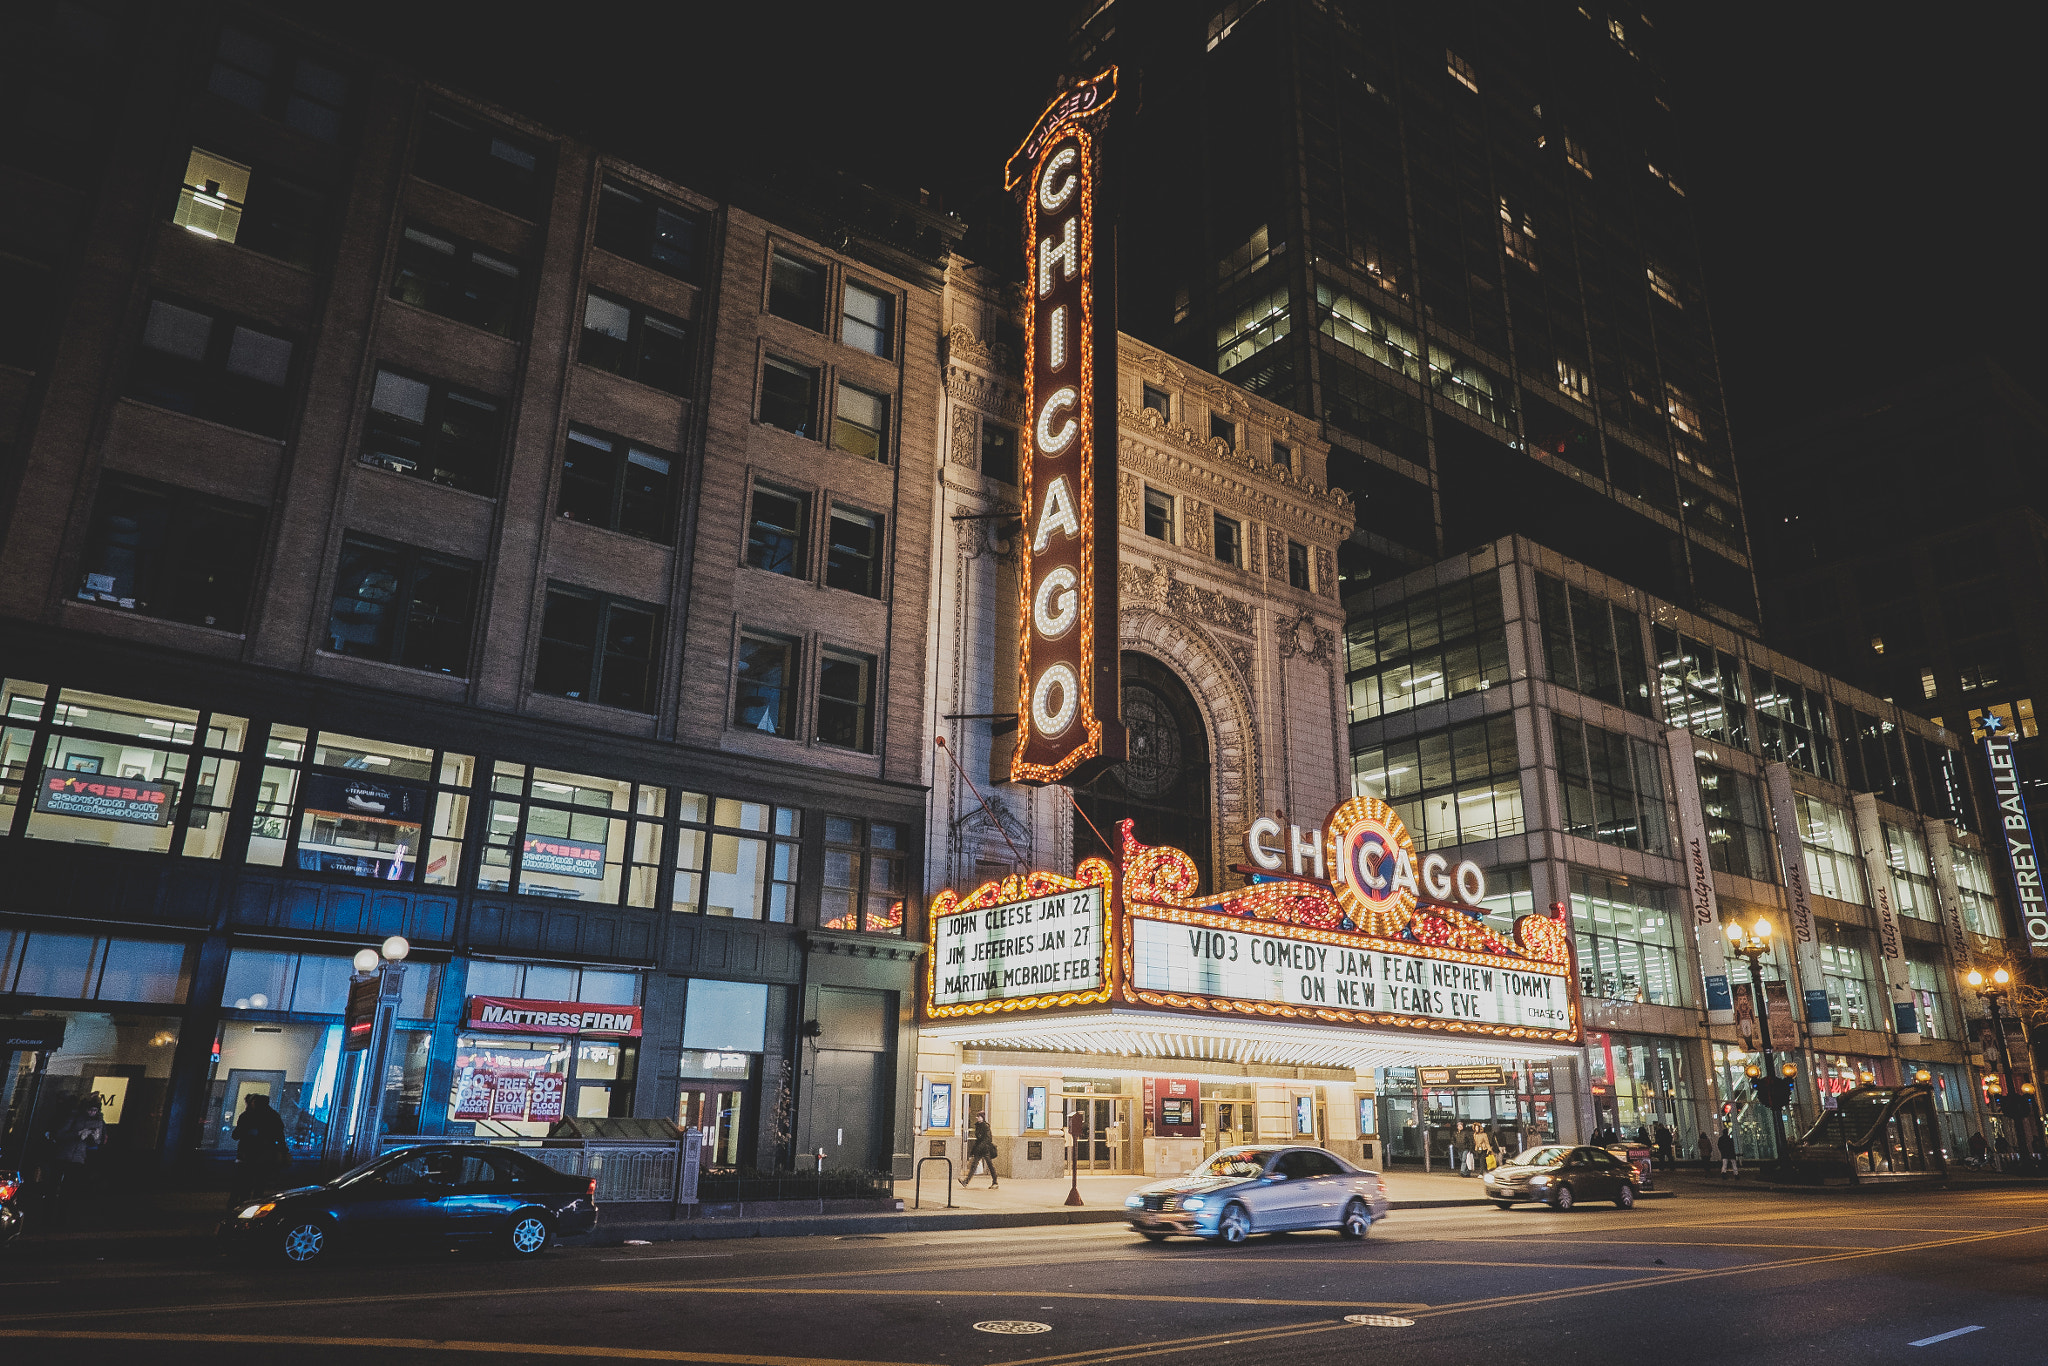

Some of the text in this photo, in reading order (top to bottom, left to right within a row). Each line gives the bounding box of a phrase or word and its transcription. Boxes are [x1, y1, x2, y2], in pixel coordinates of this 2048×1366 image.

[1033, 148, 1077, 736] CHICAGO
[1987, 739, 2027, 831] BALLET
[1250, 817, 1486, 906] CHICAGO
[1690, 837, 1712, 926] Walgreens
[947, 893, 1090, 937] JOHN CLEESE JAN 22
[1789, 863, 1811, 944] Walgreens
[1877, 886, 1899, 961] Walgreens
[946, 926, 1090, 965] JIM JEFFERIES JAN 27
[944, 970, 998, 994] MARTINA
[1003, 962, 1060, 988] MCBRIDE
[1063, 958, 1090, 980] FEB
[1251, 938, 1328, 972] COMEDY
[1336, 950, 1373, 978] JAM
[1383, 956, 1423, 985] FEAT
[1432, 963, 1493, 992] NEPHEW
[1502, 972, 1552, 1000] TOMMY
[1301, 975, 1481, 1018] ON NEW YEARS EVE
[1528, 1007, 1556, 1019] CHASE
[460, 1087, 491, 1100] OFF
[497, 1077, 528, 1090] FREE
[497, 1091, 523, 1103] BOX
[531, 1091, 561, 1103] OFF
[533, 1077, 563, 1092] 50%
[494, 1104, 524, 1114] EVENT
[530, 1102, 560, 1110] FLOOR
